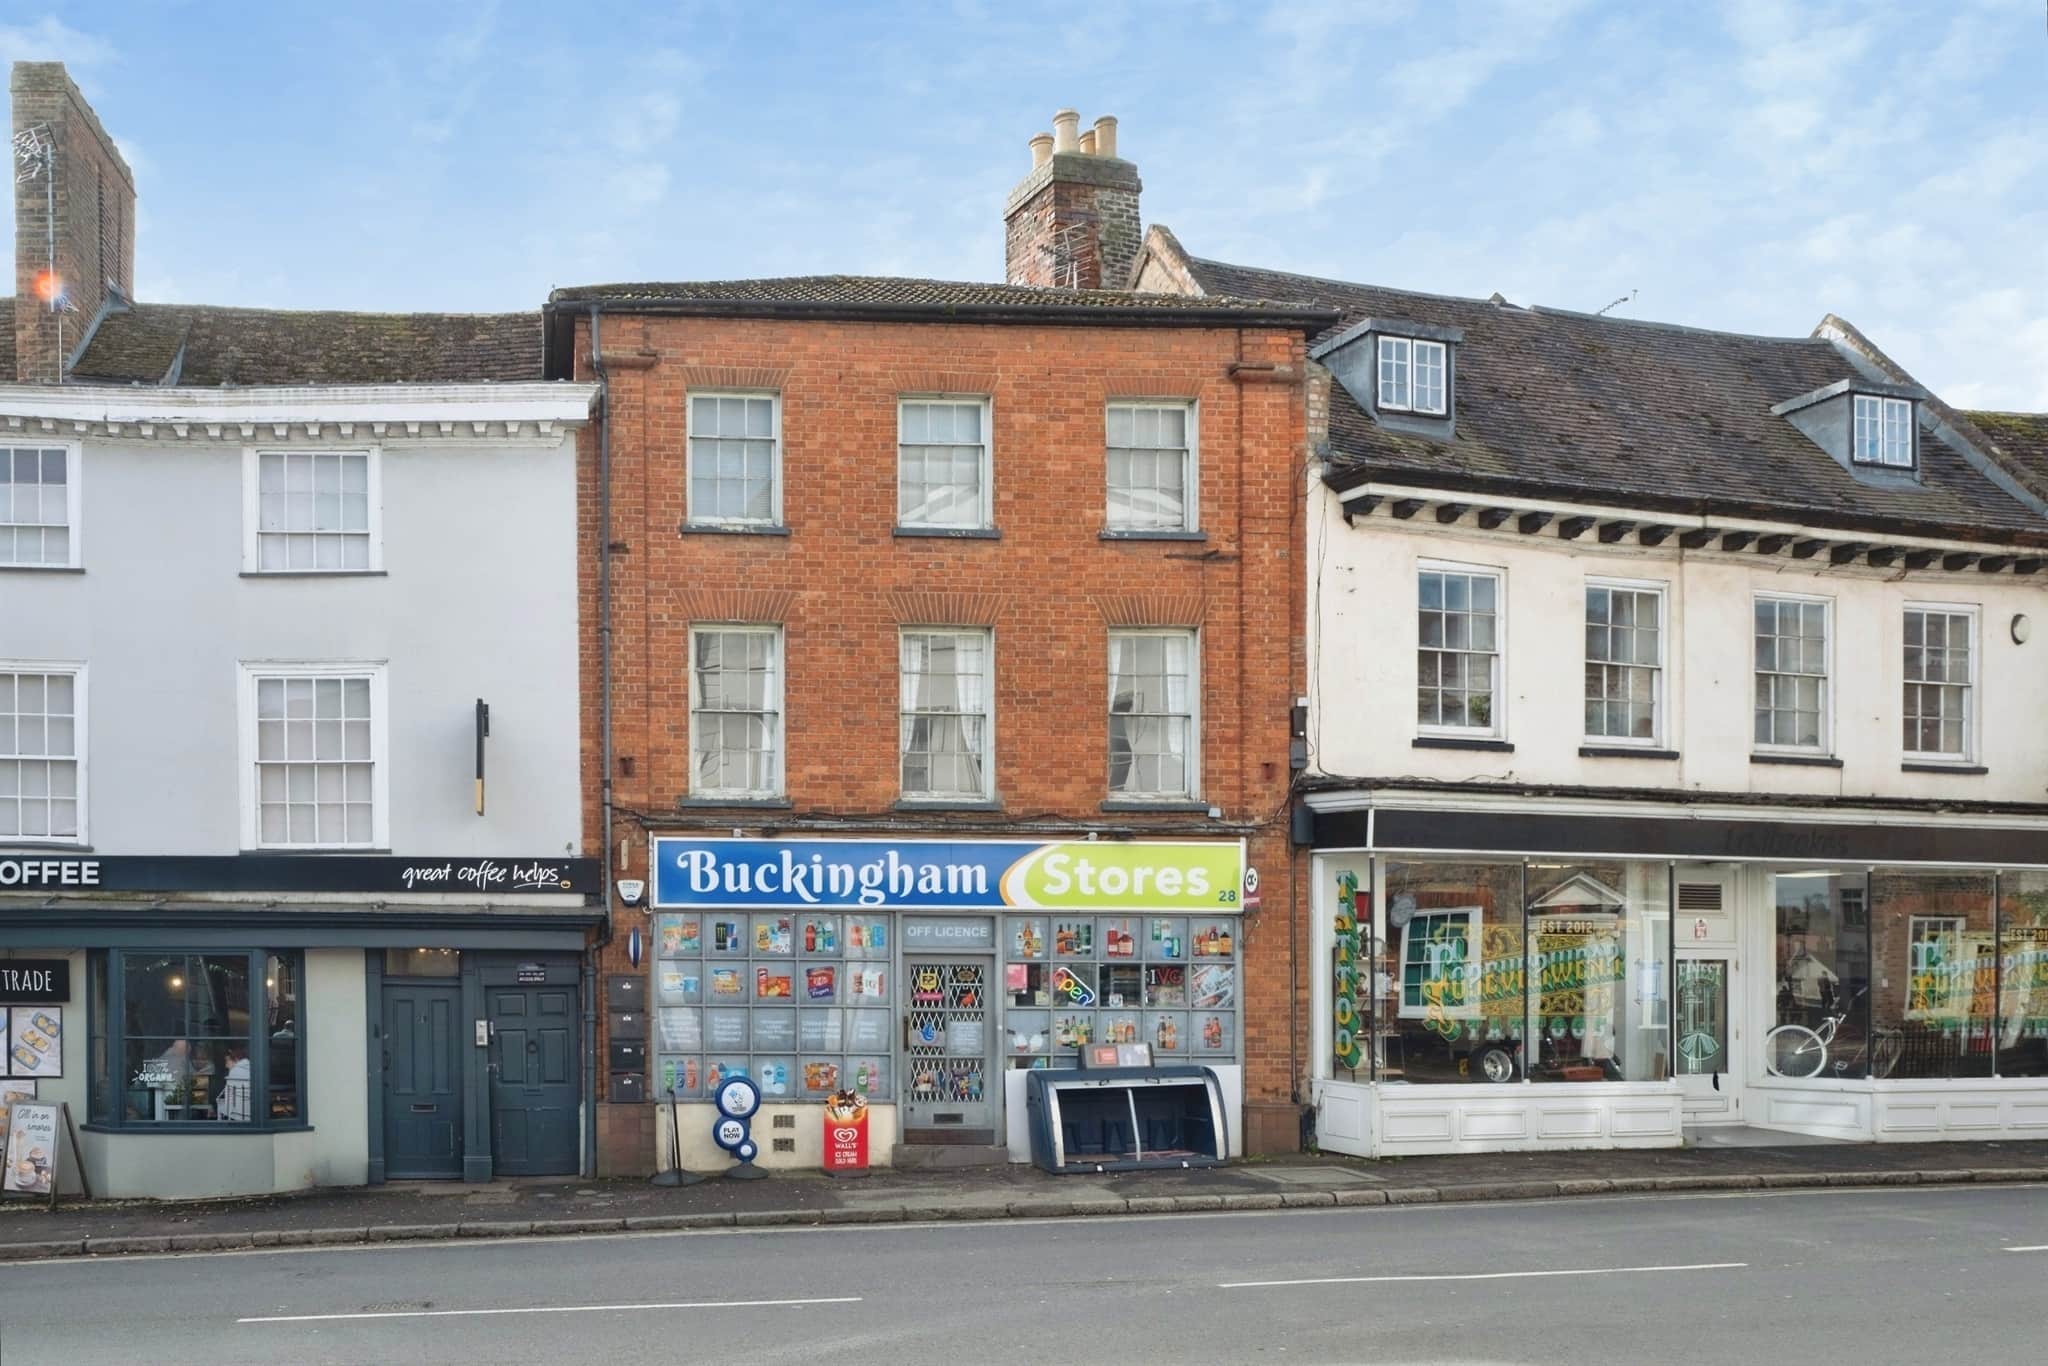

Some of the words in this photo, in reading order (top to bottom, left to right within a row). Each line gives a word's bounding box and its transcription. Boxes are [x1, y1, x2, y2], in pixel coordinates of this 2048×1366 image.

[402, 863, 452, 889] great
[457, 860, 508, 891] coffee
[513, 861, 559, 889] helps
[677, 850, 989, 906] Buckingham
[1043, 853, 1210, 896] Stores
[1218, 890, 1237, 902] 28
[907, 926, 930, 937] OFF
[935, 927, 988, 937] LICENCE
[1541, 921, 1561, 934] EST
[1566, 921, 1594, 934] 2012
[1, 969, 53, 992] TRADE
